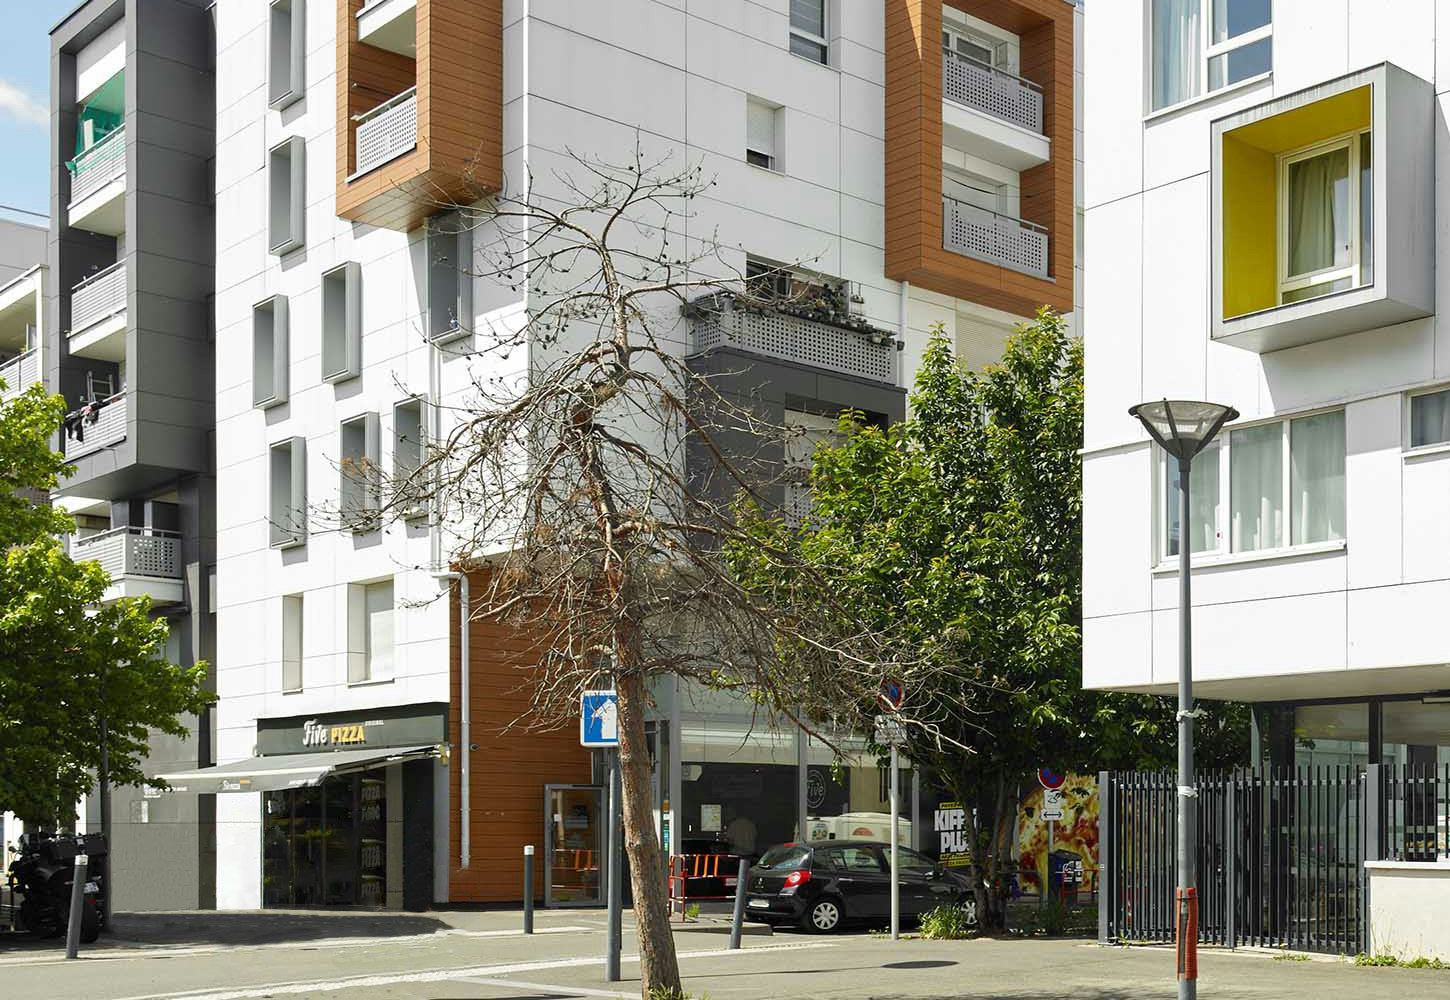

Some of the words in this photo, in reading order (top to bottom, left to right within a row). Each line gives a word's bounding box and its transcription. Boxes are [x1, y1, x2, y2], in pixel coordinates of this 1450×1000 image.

[302, 719, 328, 746] Five
[331, 725, 366, 744] PIZZA
[940, 830, 969, 853] PLU
